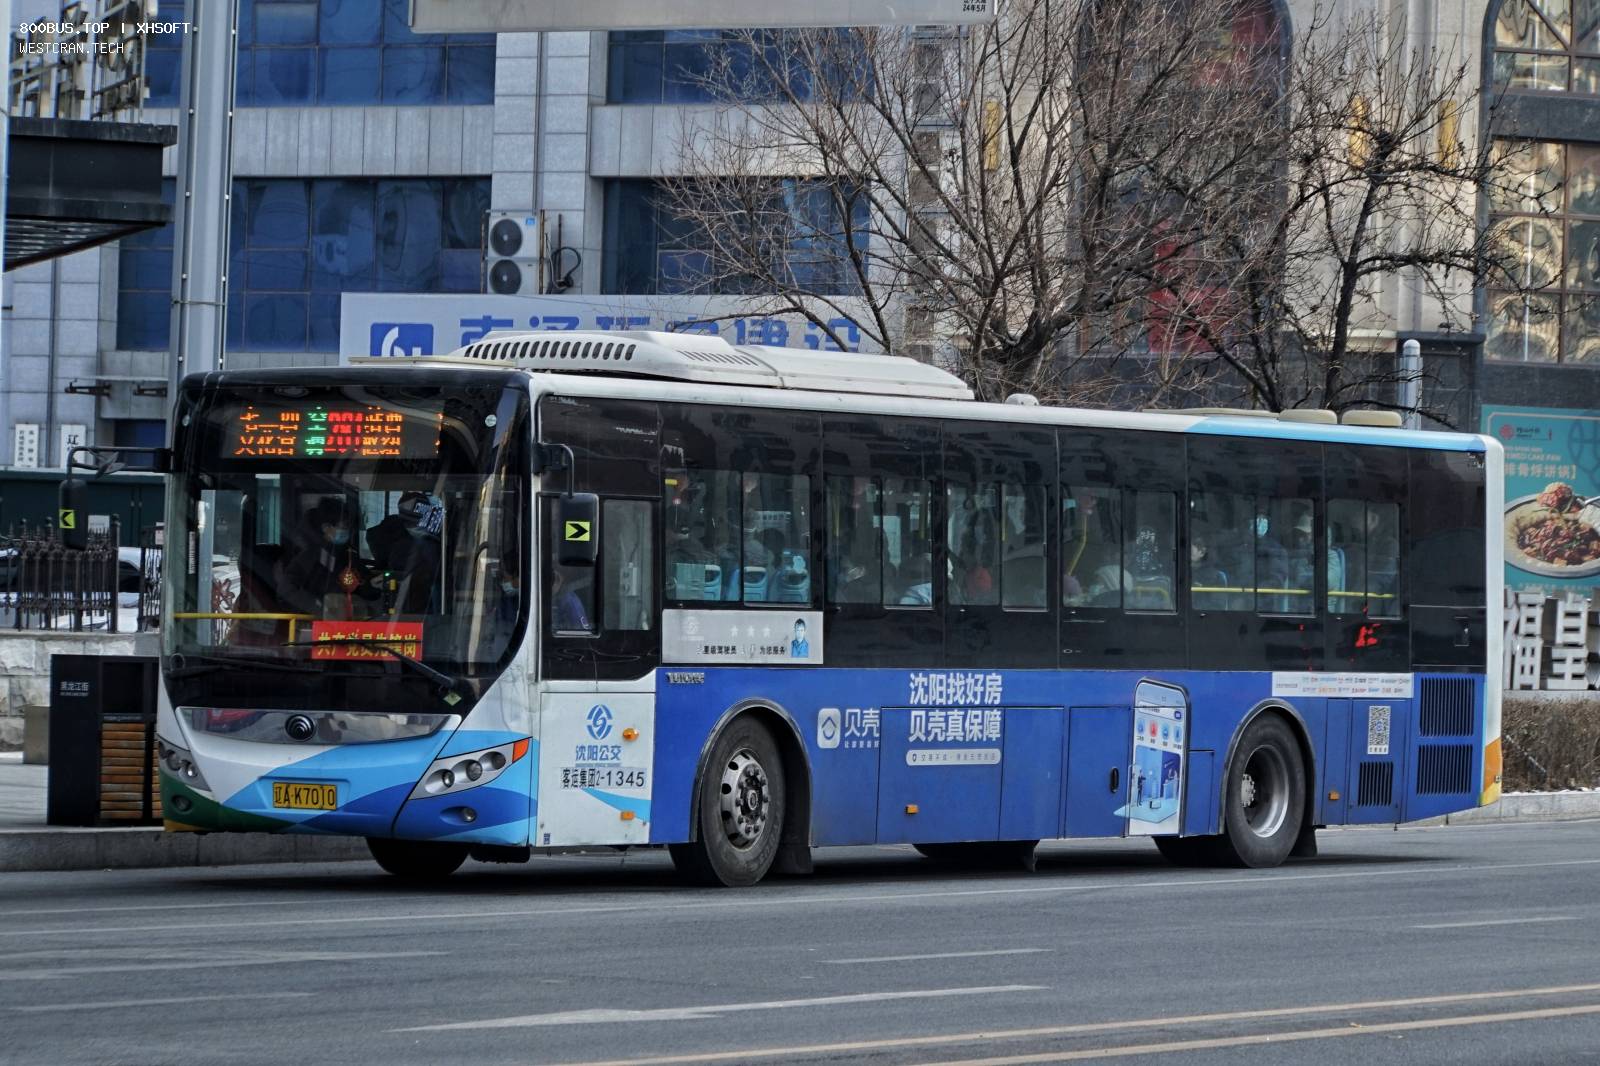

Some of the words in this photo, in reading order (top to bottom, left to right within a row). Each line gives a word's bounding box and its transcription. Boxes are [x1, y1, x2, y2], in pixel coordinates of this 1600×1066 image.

[909, 672, 1003, 706] 沈阳找好房
[844, 708, 880, 738] 贝壳
[908, 709, 1002, 742] 贝壳真保障
[575, 745, 622, 761] 沈阳公交
[562, 768, 646, 788] 客运集团2-1345
